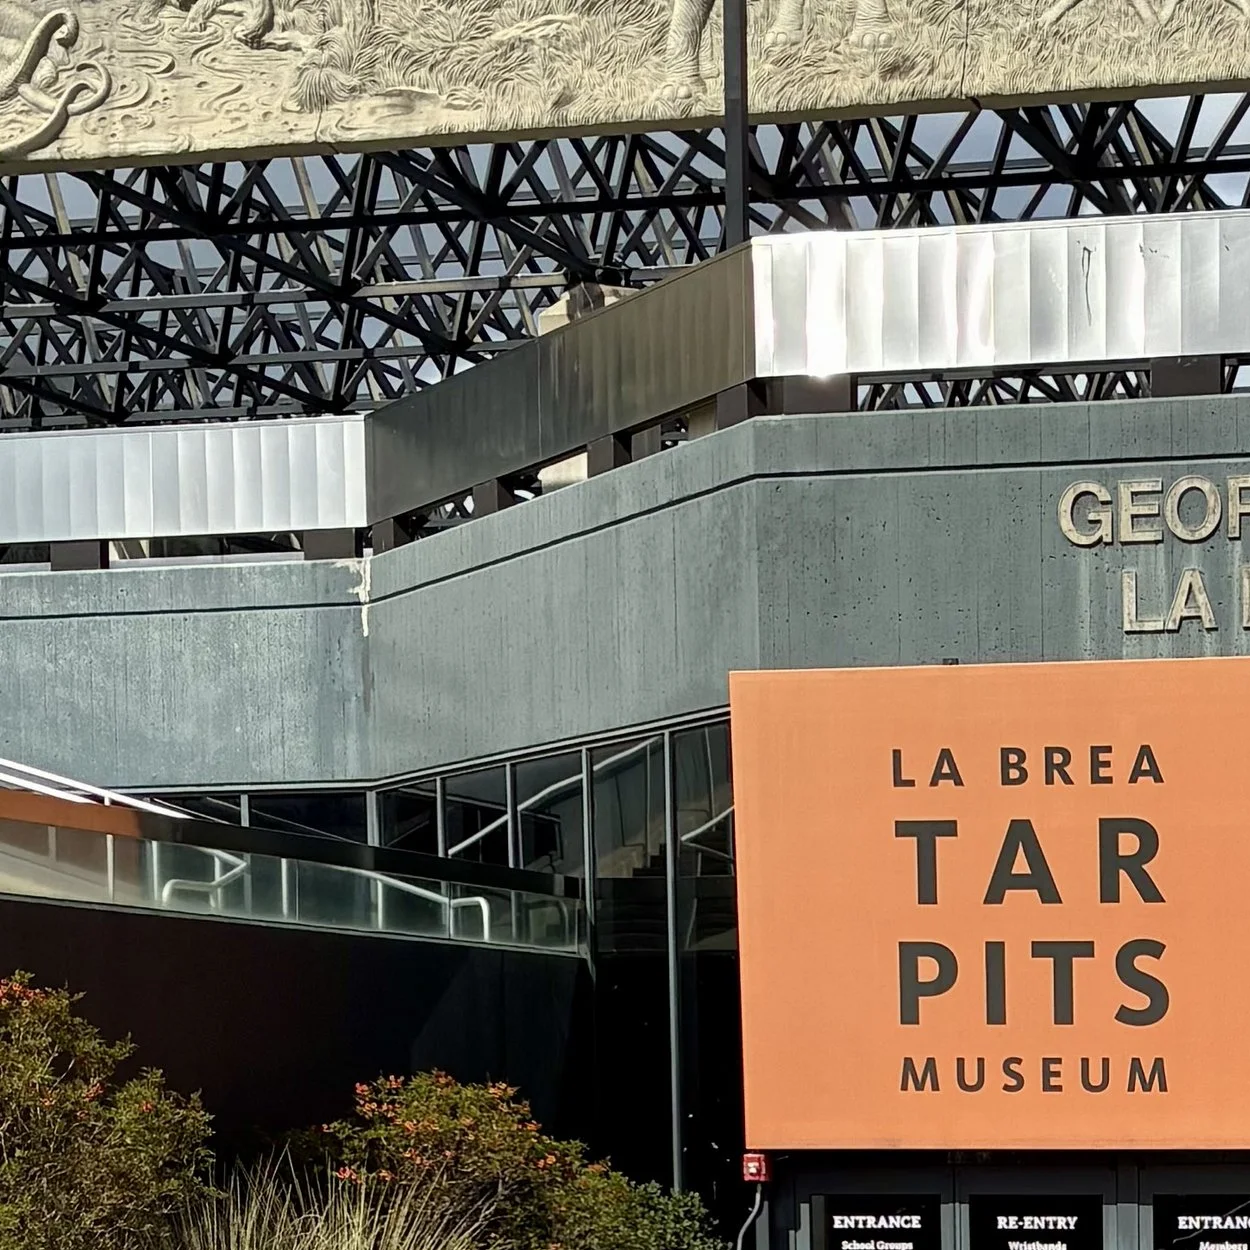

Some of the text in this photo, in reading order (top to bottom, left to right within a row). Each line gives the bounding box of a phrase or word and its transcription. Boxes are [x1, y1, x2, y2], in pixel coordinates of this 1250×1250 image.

[1121, 567, 1219, 634] LA
[892, 744, 1165, 788] LA BREA
[894, 817, 1167, 905] TAR
[897, 938, 1170, 1027] PITS
[900, 1056, 1169, 1093] MUSEUM
[832, 1215, 922, 1229] ENTRANCE
[996, 1215, 1078, 1230] RE-ENTRY
[841, 1240, 875, 1250] School
